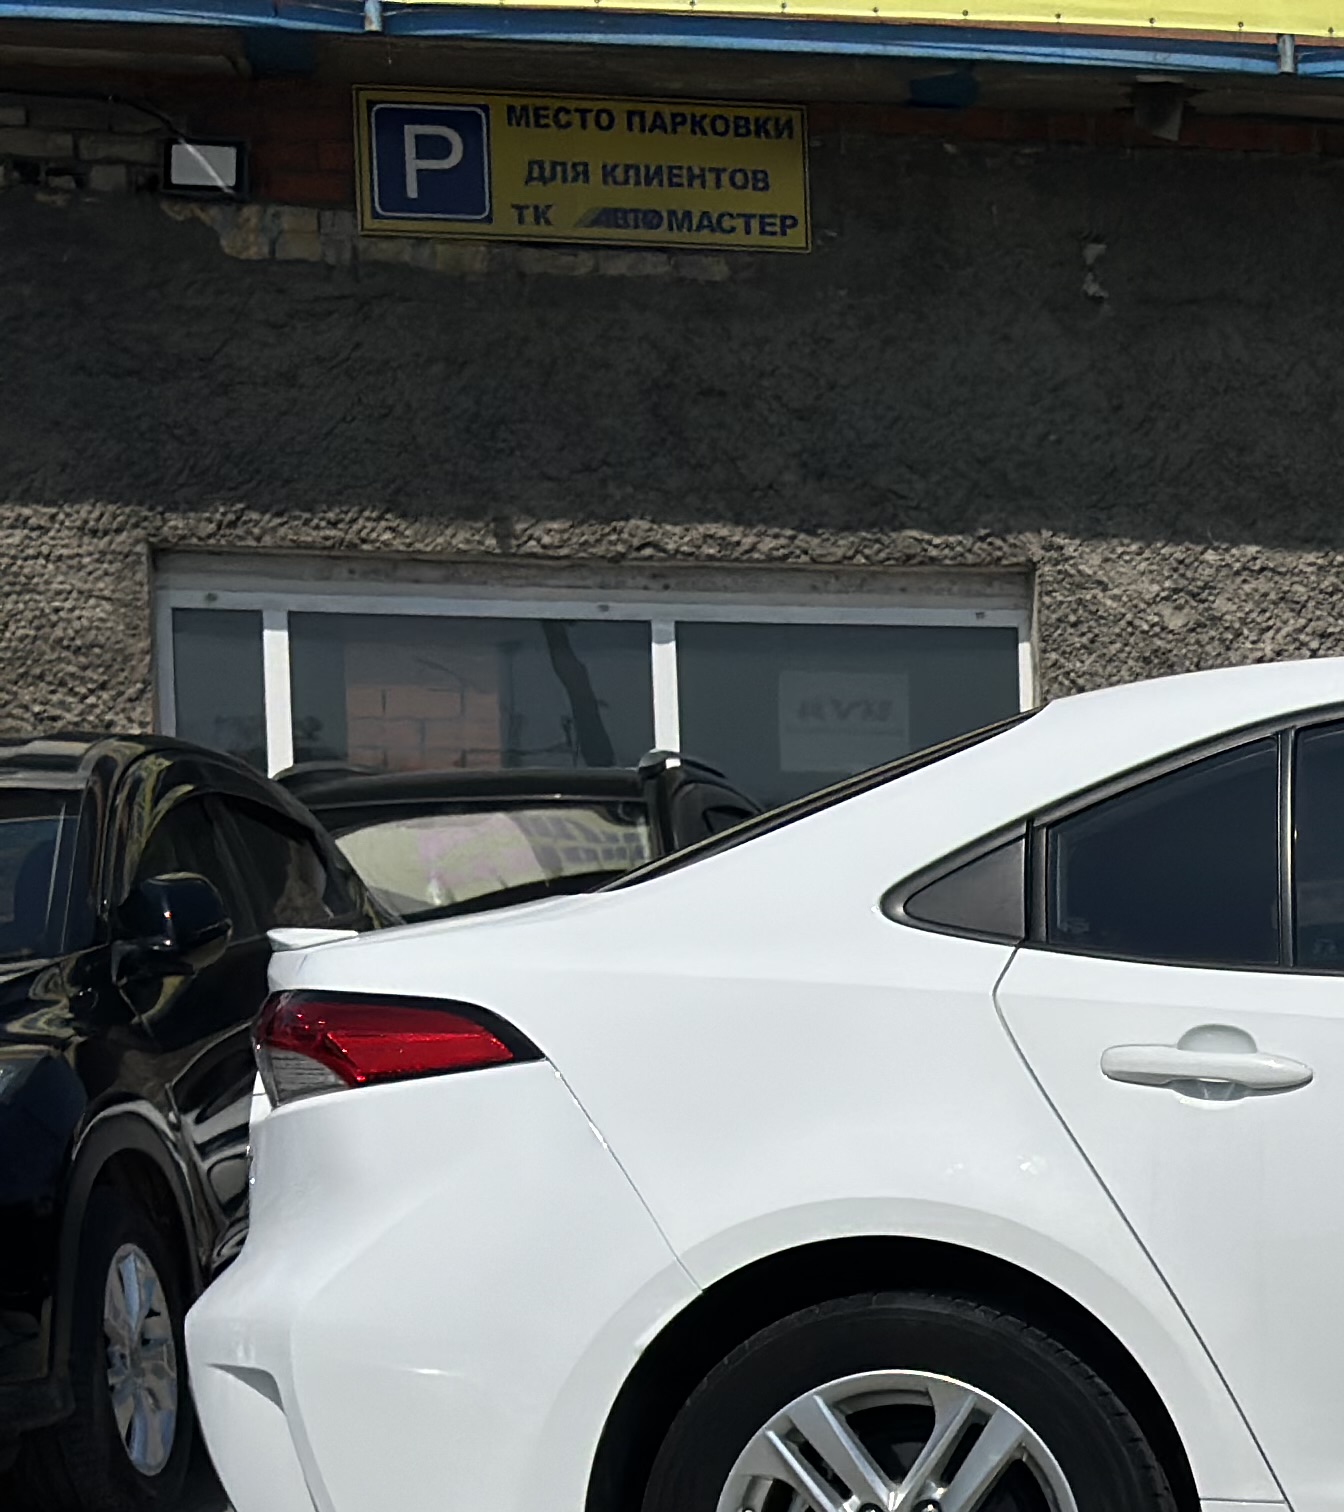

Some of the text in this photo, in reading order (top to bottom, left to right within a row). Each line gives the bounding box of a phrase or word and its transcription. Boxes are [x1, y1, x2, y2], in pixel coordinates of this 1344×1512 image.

[505, 104, 794, 139] МЕСТО ПАРКОВКИ
[405, 125, 464, 199] P
[524, 160, 771, 191] ДЛЯ КЛИЕНТОВ
[510, 204, 554, 226] ТК
